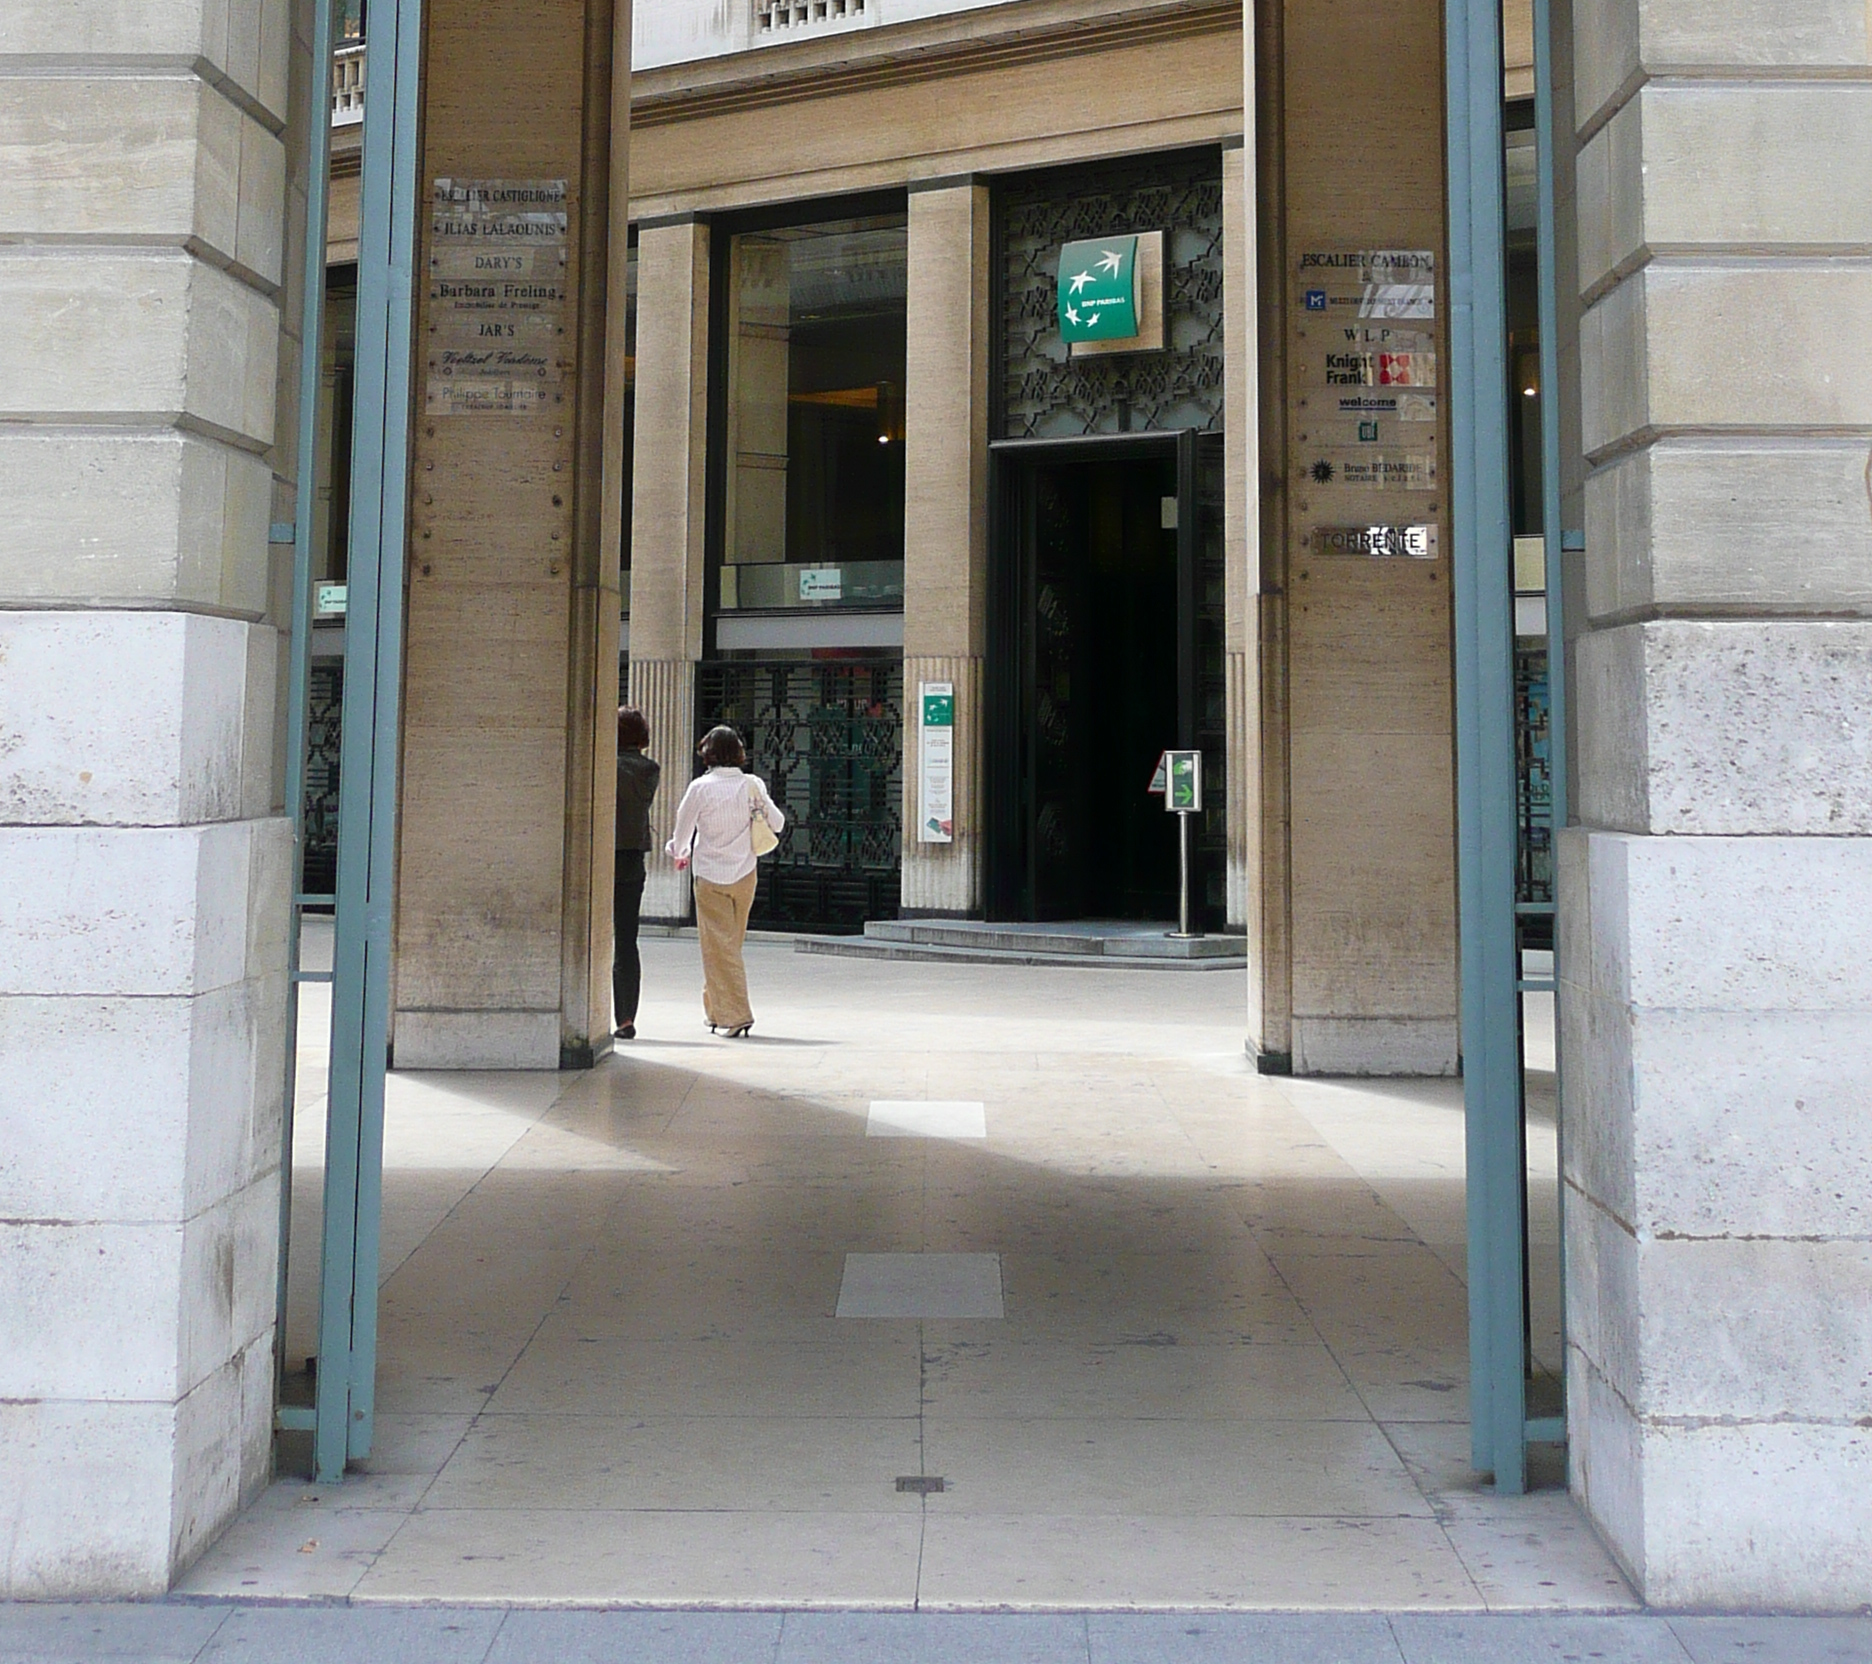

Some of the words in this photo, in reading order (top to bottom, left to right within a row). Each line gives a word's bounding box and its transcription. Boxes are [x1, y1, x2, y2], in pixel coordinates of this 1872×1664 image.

[492, 189, 561, 203] CASTIGLIONE
[444, 222, 479, 236] ILIAS
[482, 222, 556, 236] LALAOUNIS
[474, 255, 524, 270] DARY'S
[1302, 253, 1367, 268] ESCALIER
[1370, 254, 1430, 268] CAMBON
[439, 283, 496, 298] Barbara
[478, 323, 515, 337] JAR'S
[1339, 396, 1397, 406] welcome
[1321, 532, 1421, 549] TORRENTE
